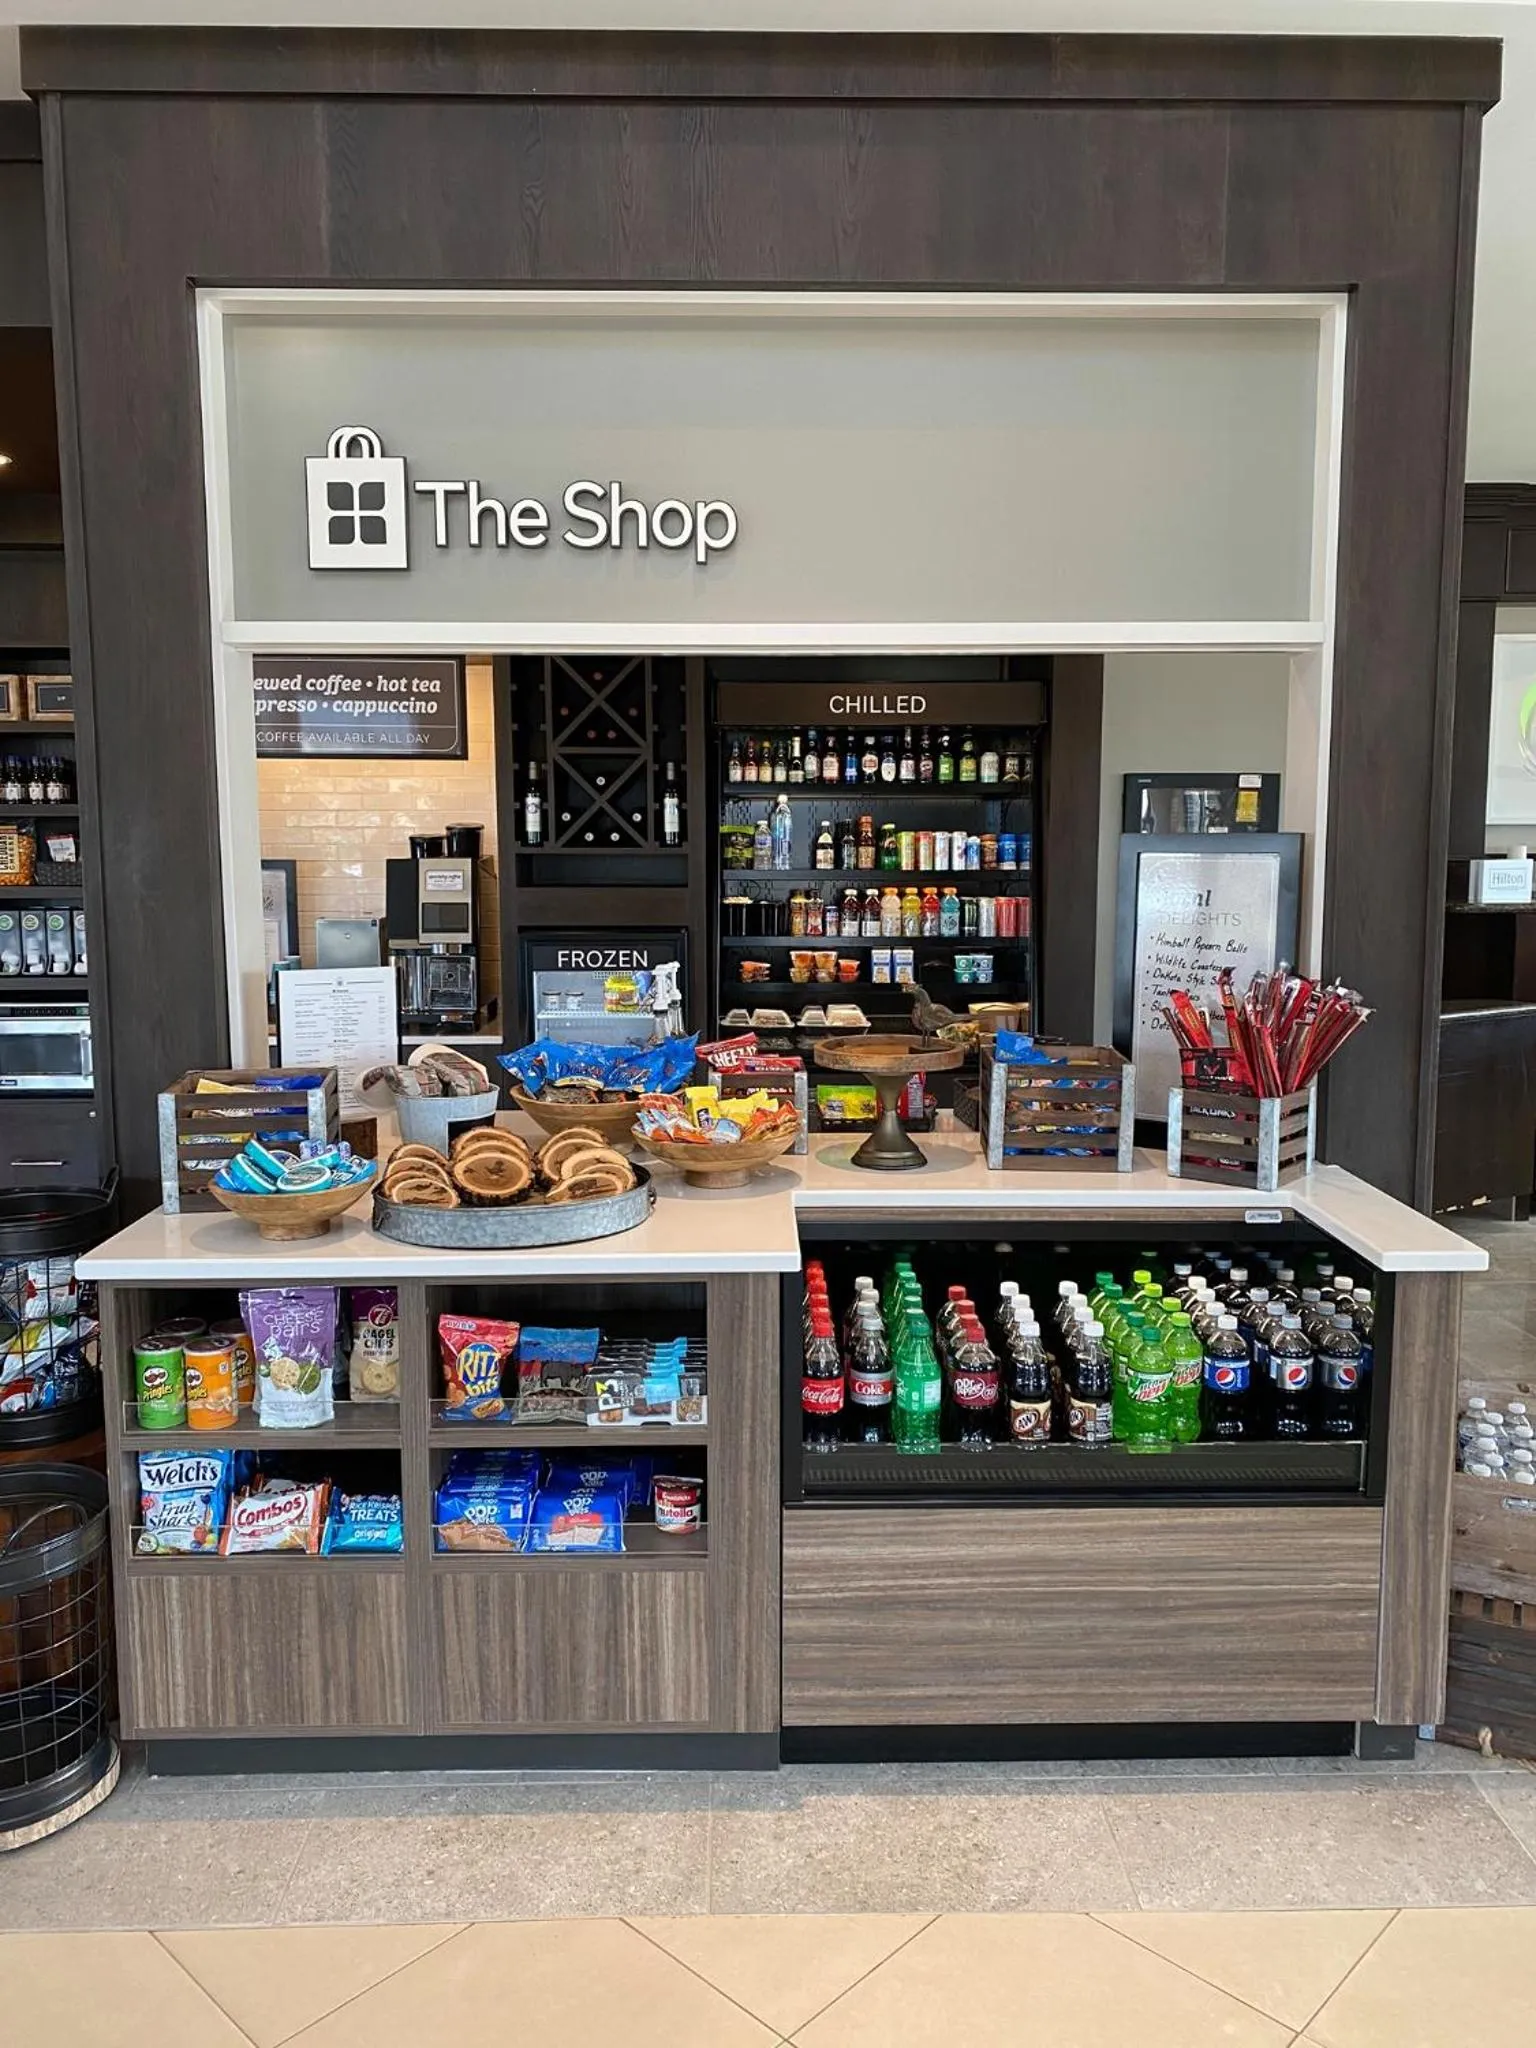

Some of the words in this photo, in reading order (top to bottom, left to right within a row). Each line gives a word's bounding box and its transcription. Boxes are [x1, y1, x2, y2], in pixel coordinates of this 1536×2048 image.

[413, 480, 550, 548] The
[561, 479, 738, 566] Shop
[305, 674, 362, 696] coffee
[376, 675, 408, 693] hot
[411, 677, 442, 693] tea
[332, 697, 438, 717] cappuccino
[829, 695, 927, 714] CHILLED
[256, 731, 303, 744] COFFEE
[308, 732, 375, 744] AVAILABLE
[380, 733, 399, 744] ALL
[406, 734, 430, 744] DAY
[1493, 871, 1523, 885] Hilton
[557, 950, 648, 968] FROZEN
[262, 1309, 324, 1326] CHEESE
[270, 1320, 321, 1339] pairs
[459, 1348, 502, 1382] RITZ
[143, 1384, 173, 1402] Pringles
[855, 1381, 885, 1395] Coke
[144, 1461, 218, 1486] Welch's
[160, 1500, 197, 1517] Fruit
[237, 1496, 302, 1526] Combos
[350, 1509, 399, 1522] TREATS
